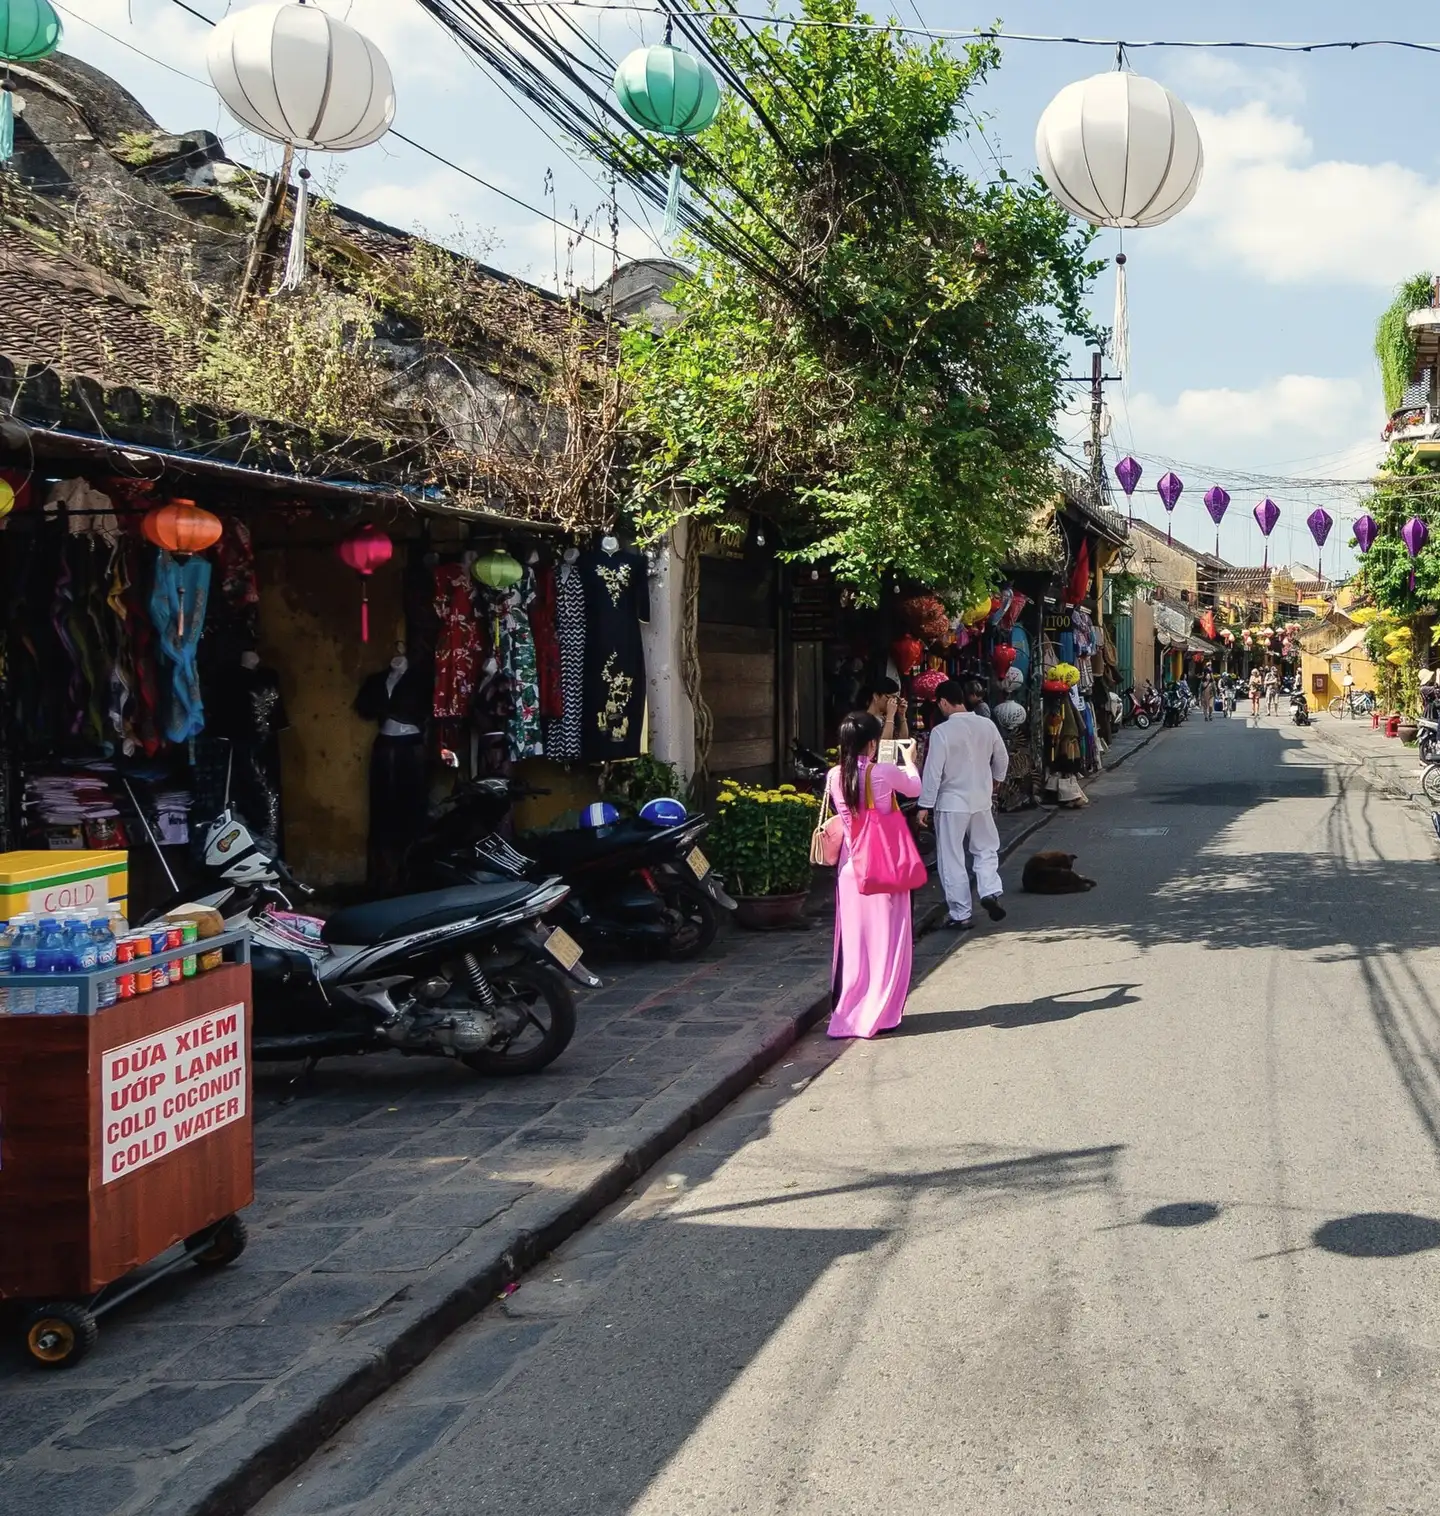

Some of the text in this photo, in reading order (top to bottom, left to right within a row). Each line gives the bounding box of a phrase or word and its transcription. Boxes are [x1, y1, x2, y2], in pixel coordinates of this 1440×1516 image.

[45, 884, 95, 912] COLD
[110, 1041, 238, 1112] ƯỚP LẠNH
[111, 1013, 237, 1081] DỪA XIÊM
[106, 1067, 242, 1145] COLD COCONUT
[111, 1097, 239, 1174] COLD WATER
